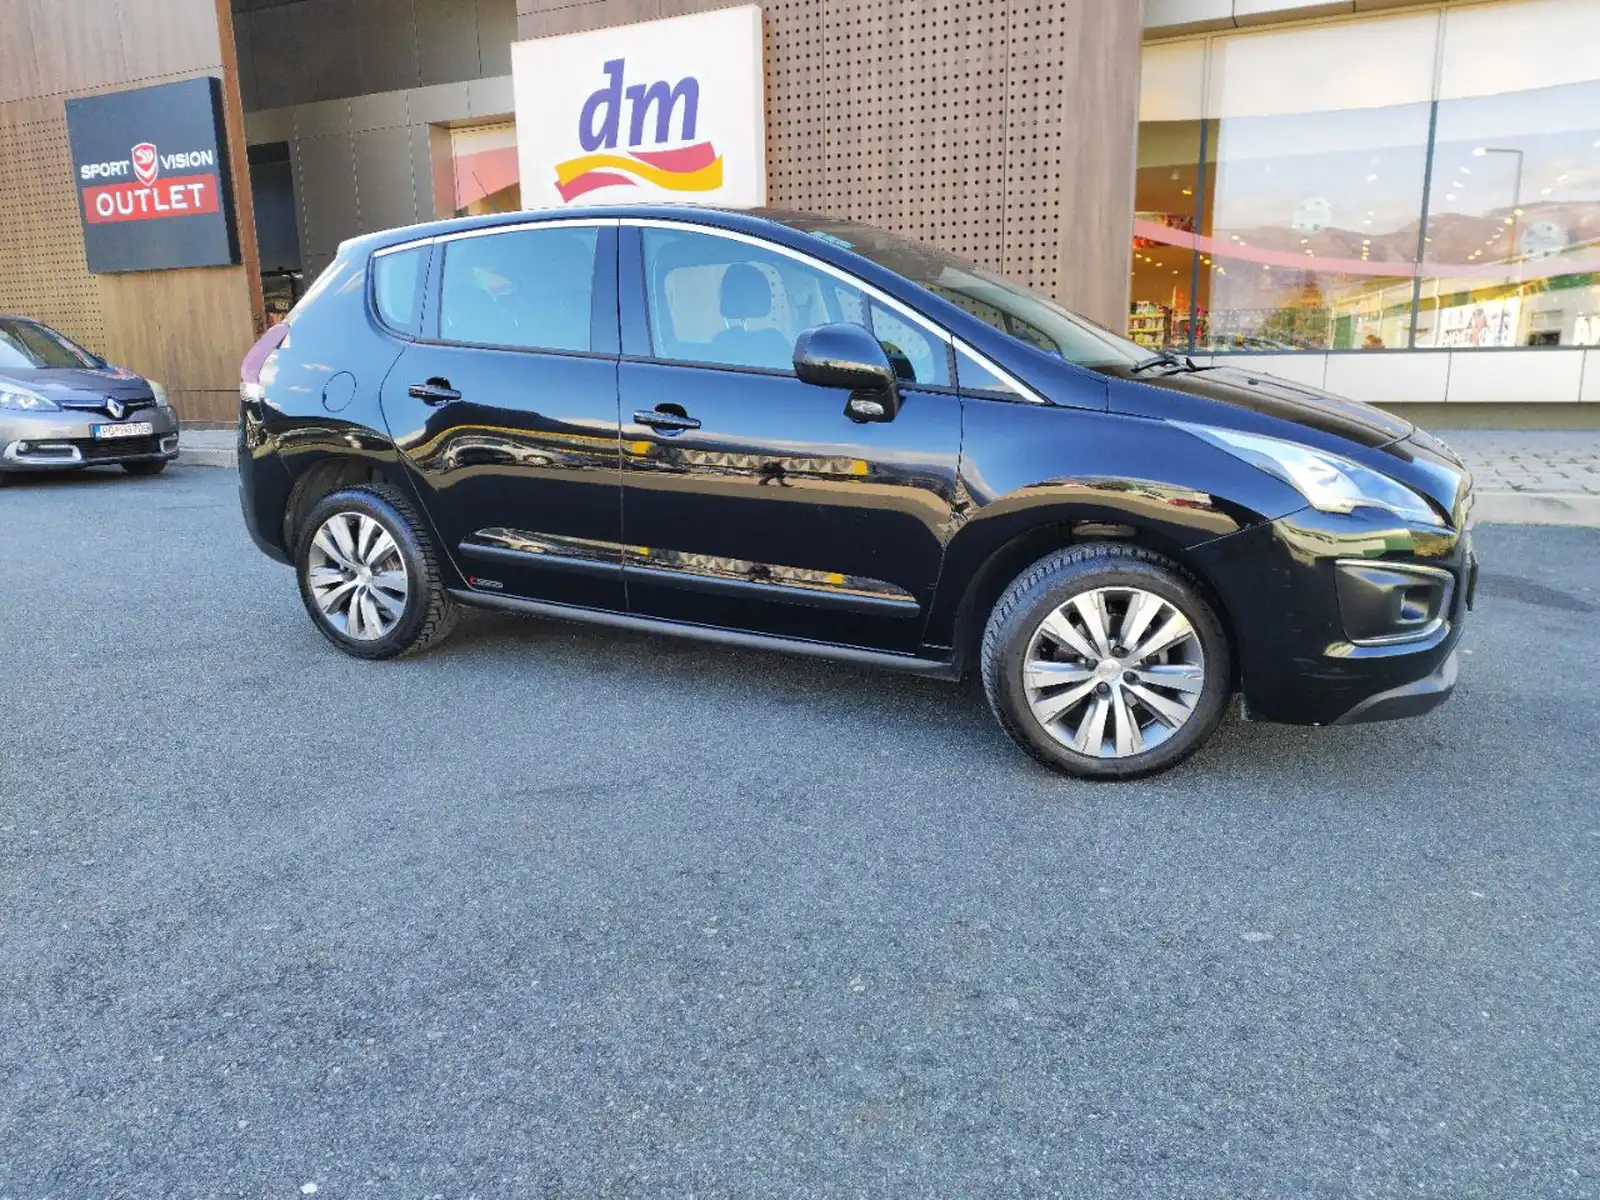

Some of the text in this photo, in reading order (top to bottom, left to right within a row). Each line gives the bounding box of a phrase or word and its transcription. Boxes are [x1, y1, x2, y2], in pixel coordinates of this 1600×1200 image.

[578, 57, 700, 152] dm
[80, 150, 213, 179] SPORT VISION
[96, 183, 205, 217] OUTLET
